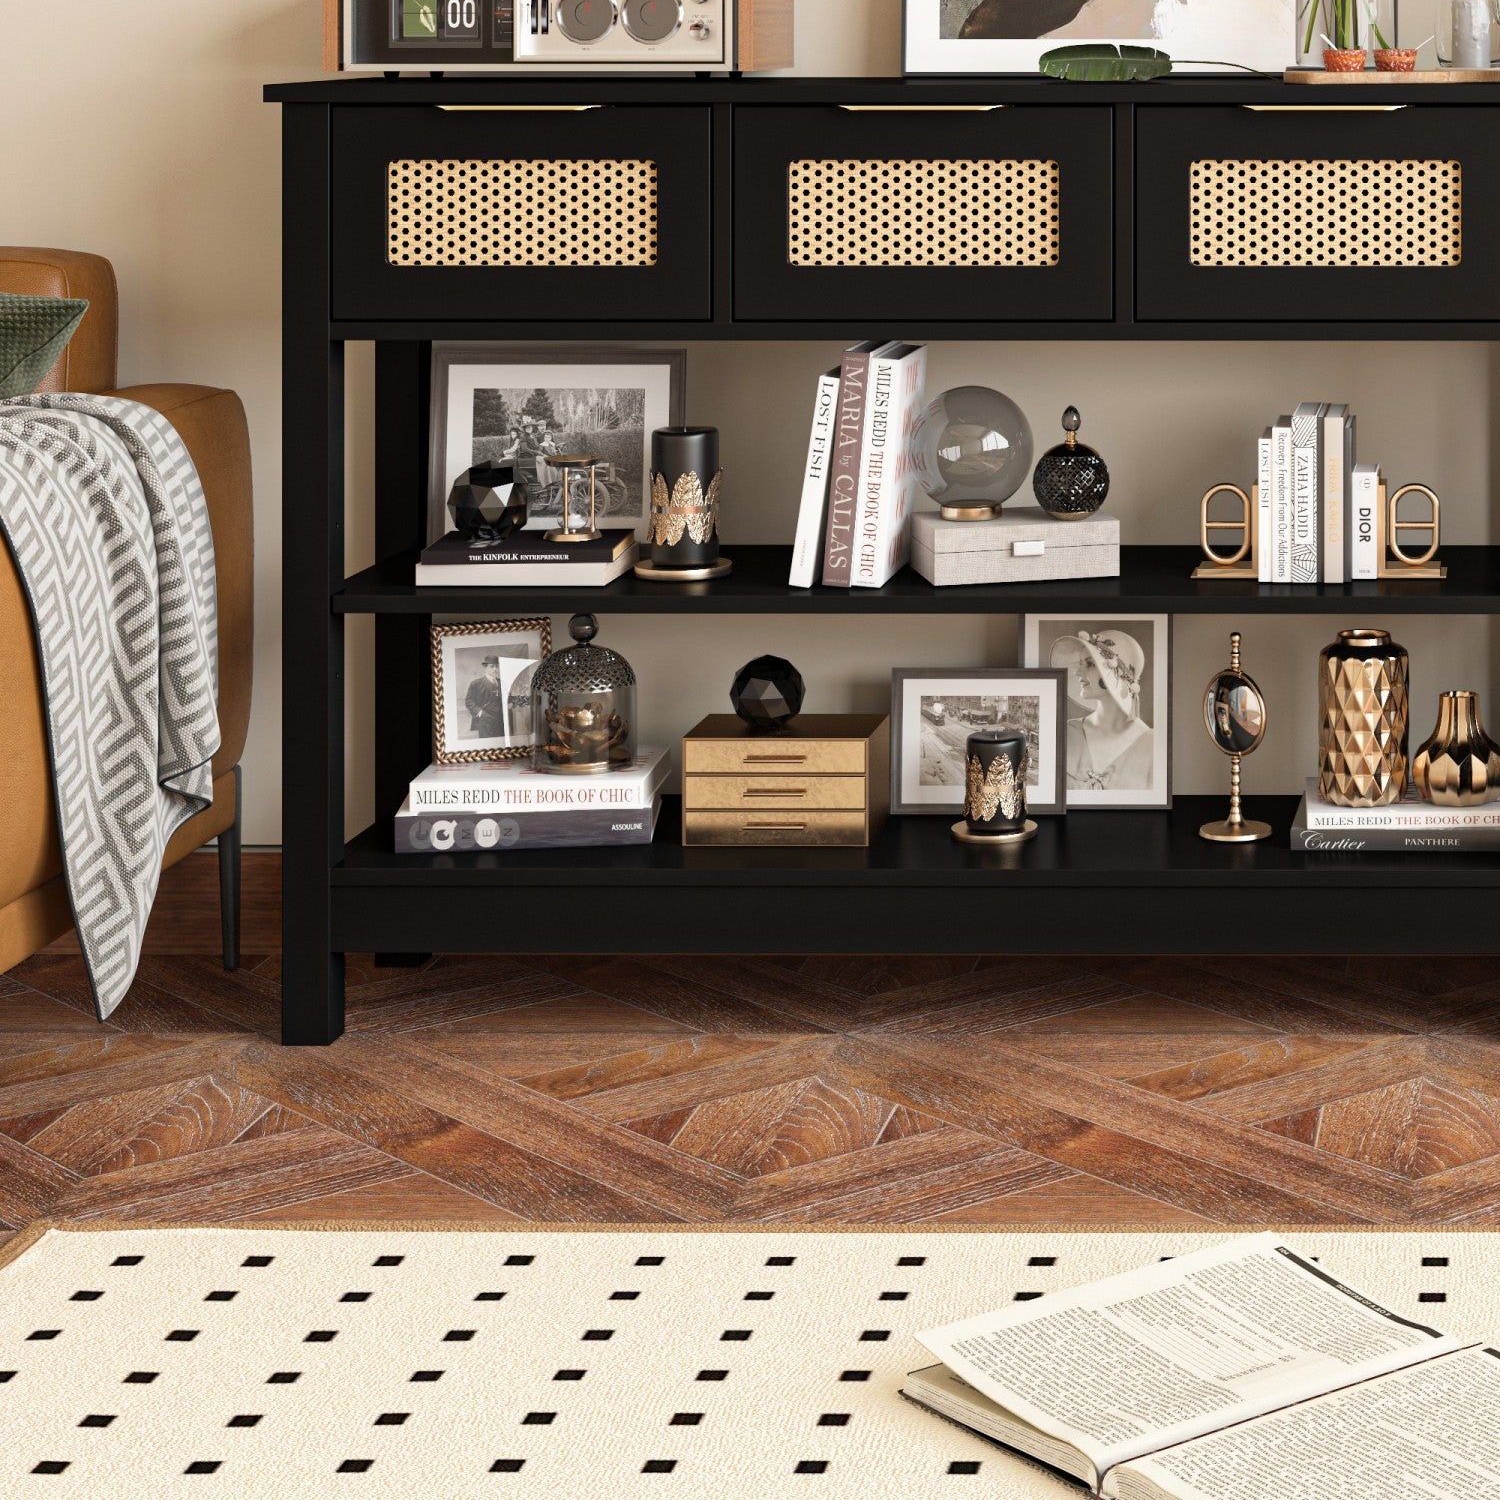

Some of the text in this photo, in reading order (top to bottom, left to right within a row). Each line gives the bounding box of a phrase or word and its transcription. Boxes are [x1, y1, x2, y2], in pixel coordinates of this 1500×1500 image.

[874, 364, 892, 408] MILES
[838, 364, 865, 448] MARIA
[808, 381, 834, 480] LOST FISH
[871, 410, 888, 448] REDD
[838, 454, 853, 468] by
[867, 451, 884, 479] THE
[1260, 442, 1270, 509] LOST FISH
[863, 481, 881, 520] BOOK
[1277, 469, 1288, 502] Freedom
[1297, 455, 1309, 539] ZAHA HADID
[1328, 457, 1340, 544] FRIDA KAHLO
[828, 474, 855, 570] CALLAS
[1277, 502, 1288, 523] From
[1359, 507, 1371, 543] DIOR
[862, 522, 877, 542] OF
[1277, 522, 1288, 538] Our
[483, 553, 519, 561] KINFOLK
[859, 543, 875, 578] CHIC
[1277, 538, 1288, 578] Addictions
[415, 790, 459, 805] MILES
[462, 789, 501, 804] REDD
[503, 789, 532, 804] THE
[535, 788, 574, 804] BOOK
[576, 788, 597, 803] OF
[599, 787, 633, 803] CHIC
[611, 821, 643, 832] ASSOULINE
[1314, 816, 1355, 827] MILES
[1356, 816, 1392, 826] REDD
[1394, 816, 1421, 826] THE
[1424, 816, 1459, 826] BOOK
[1462, 815, 1480, 825] OF
[1299, 829, 1367, 850] Cartier
[1404, 837, 1461, 847] PANTHERE
